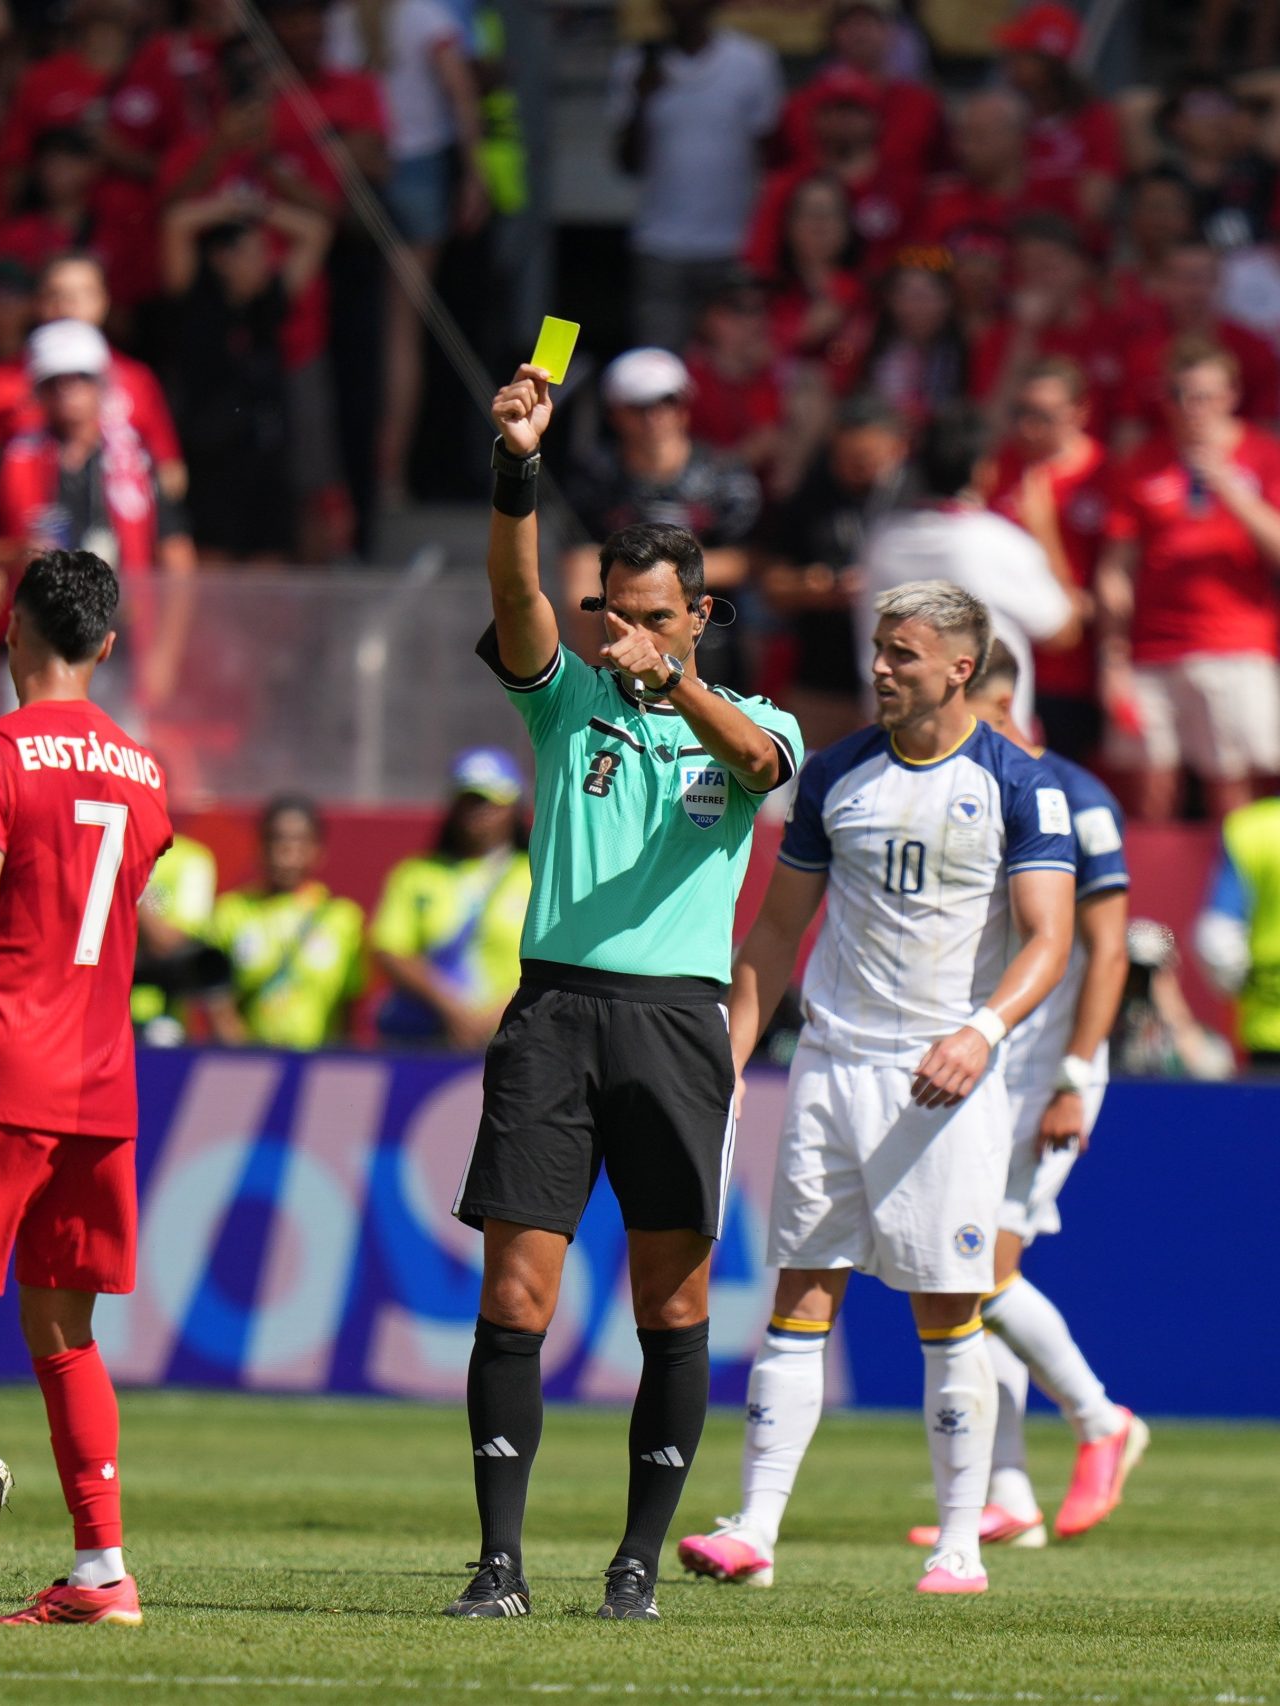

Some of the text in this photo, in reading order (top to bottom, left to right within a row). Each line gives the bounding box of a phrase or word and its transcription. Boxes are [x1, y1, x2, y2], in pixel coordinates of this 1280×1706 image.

[16, 731, 161, 789] EUSTÁQUIO
[686, 771, 726, 787] FIFA
[588, 784, 602, 794] FIFA
[685, 794, 725, 805] REFEREE
[695, 814, 714, 824] 2026
[885, 839, 926, 895] 10
[74, 800, 128, 966] 7
